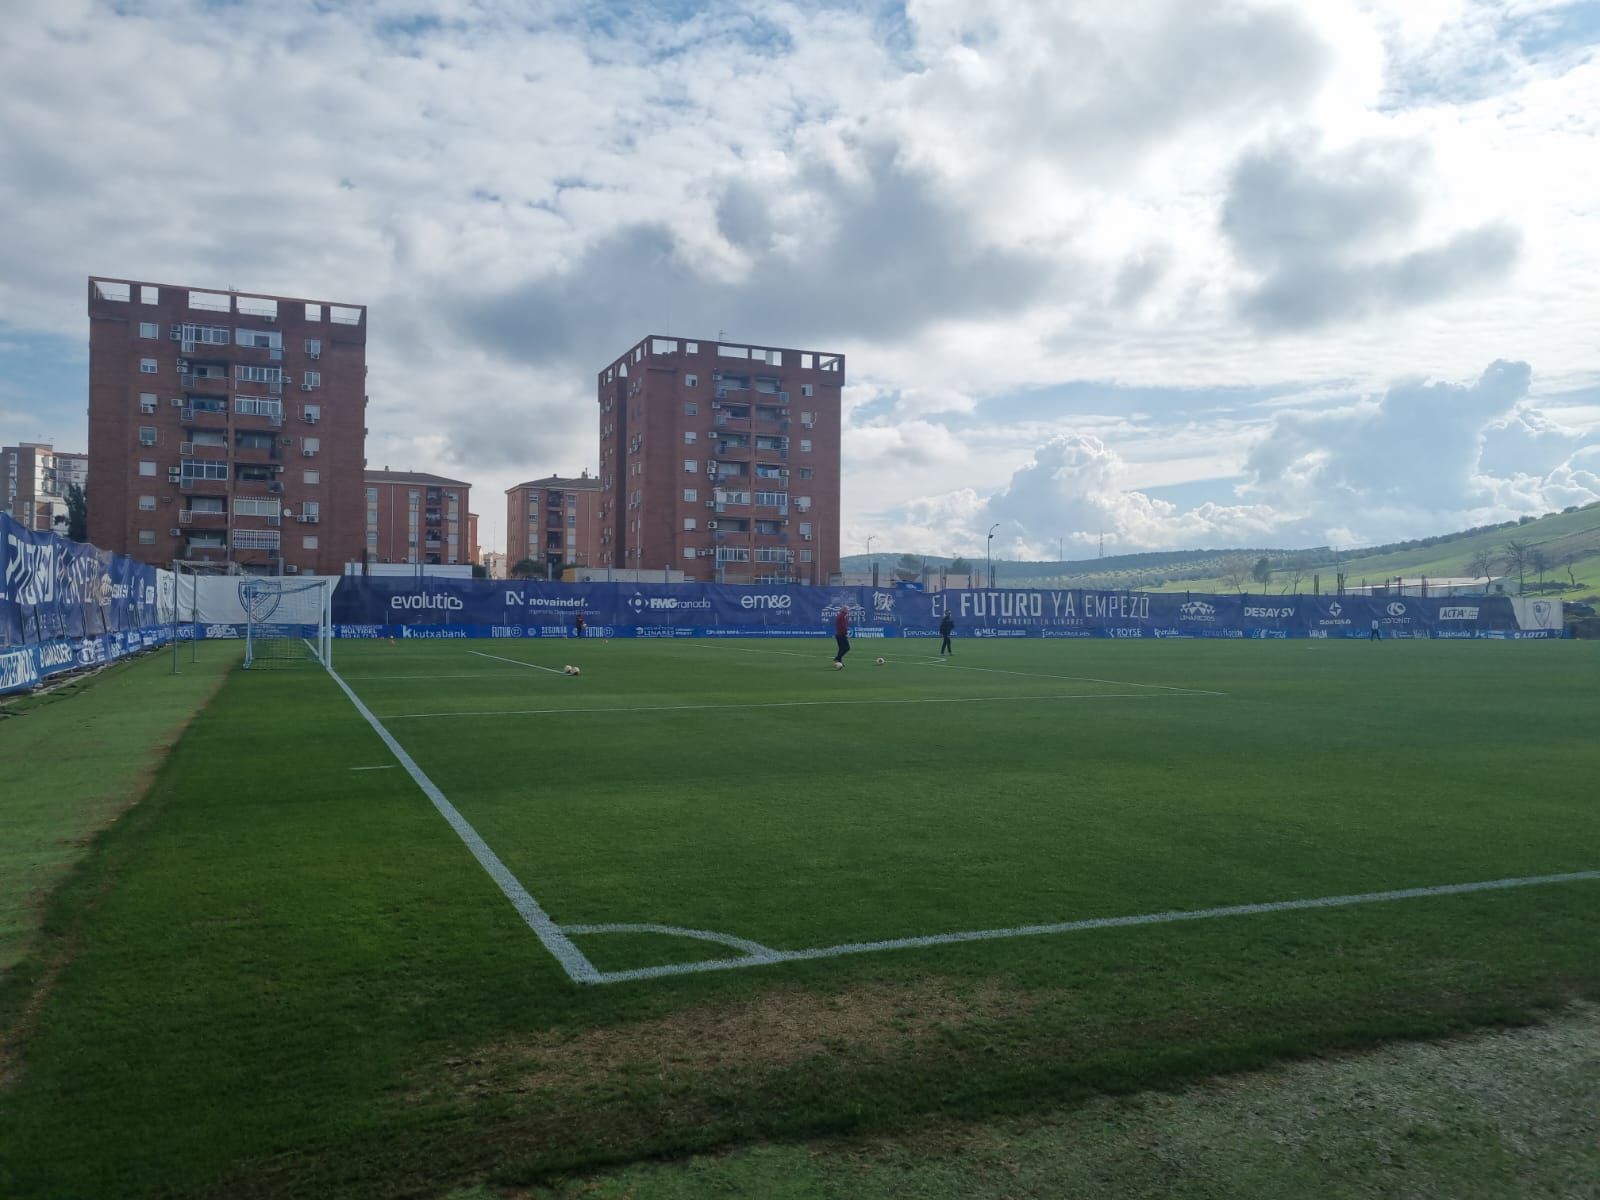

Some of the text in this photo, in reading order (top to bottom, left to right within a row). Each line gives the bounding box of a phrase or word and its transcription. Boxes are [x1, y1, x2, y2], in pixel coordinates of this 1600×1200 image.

[650, 597, 711, 609] FMGranada
[960, 592, 1042, 617] FUTURO
[1051, 592, 1077, 617] YA
[1085, 593, 1150, 619] EMPEZÓ
[1243, 607, 1296, 618] DESAY SV
[412, 628, 467, 638] kutxabank
